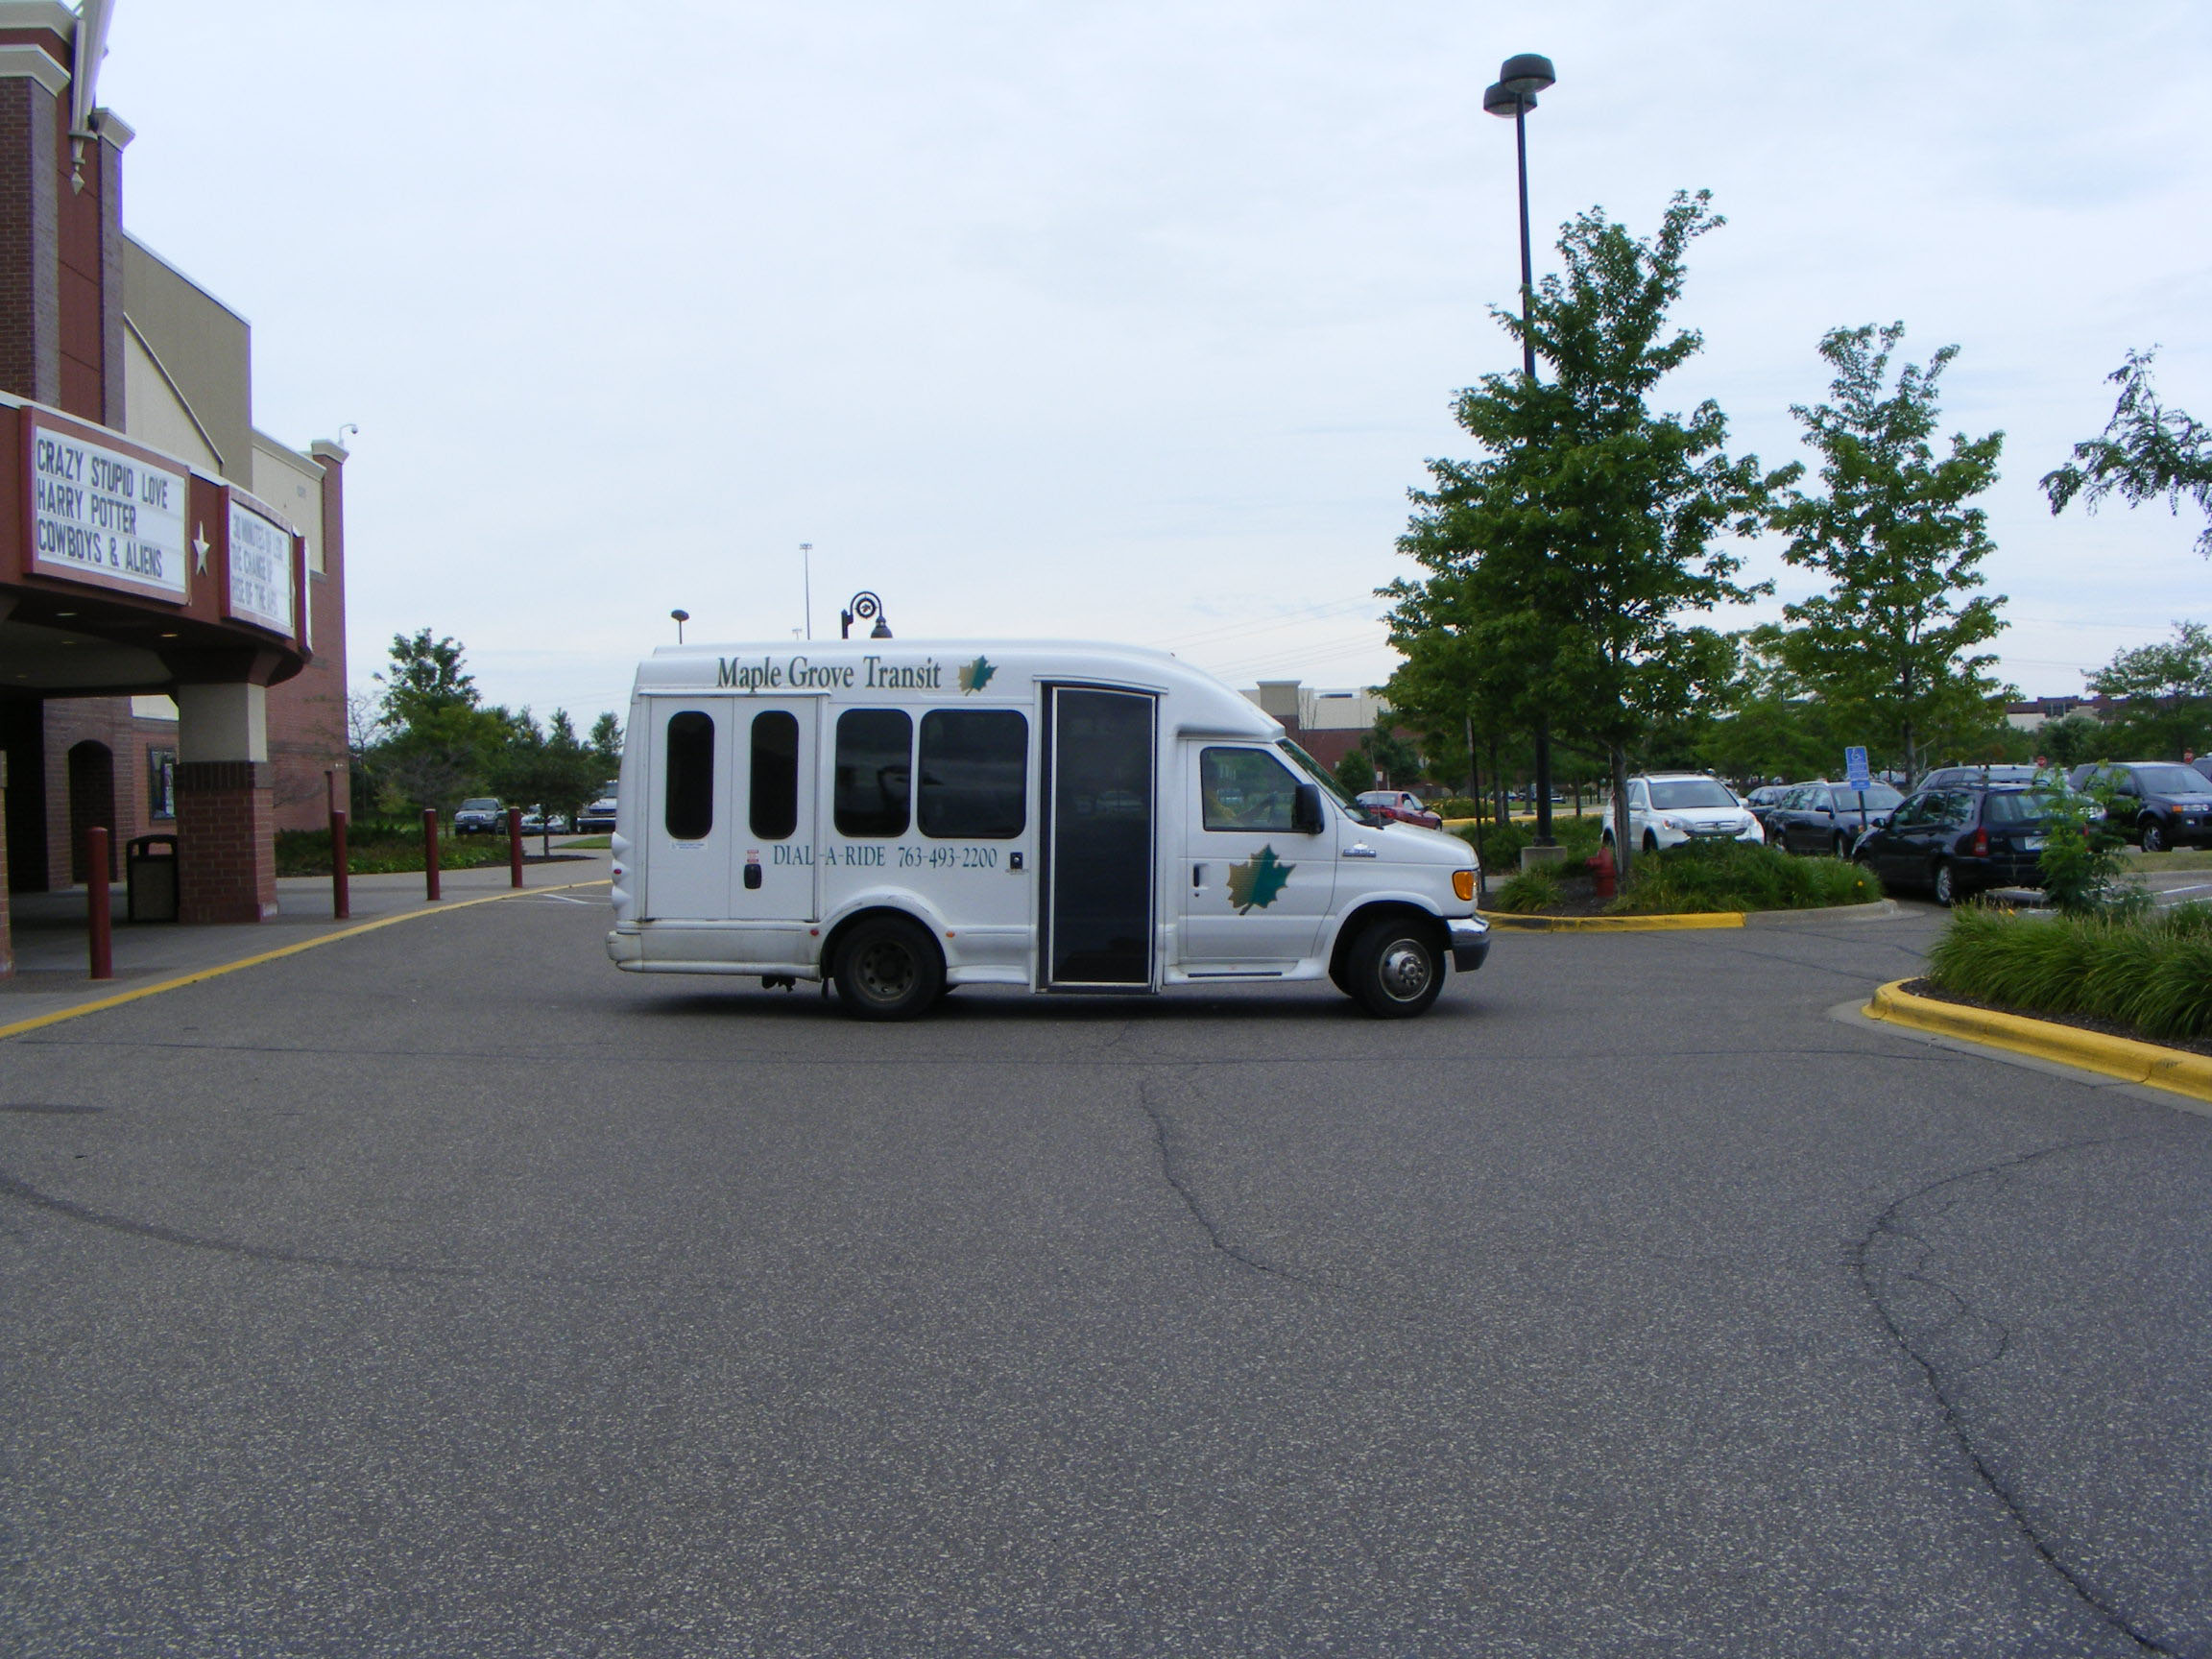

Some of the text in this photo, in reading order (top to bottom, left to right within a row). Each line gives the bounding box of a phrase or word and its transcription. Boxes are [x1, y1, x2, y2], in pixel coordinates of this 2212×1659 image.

[37, 439, 168, 510] CRAZY STUPID LOVE
[37, 478, 136, 536] HARRY POTTER
[37, 517, 162, 579] COWBOYS & ALIENS
[716, 655, 941, 692] Maple Grove Transit
[898, 846, 998, 869] 763-493-2200
